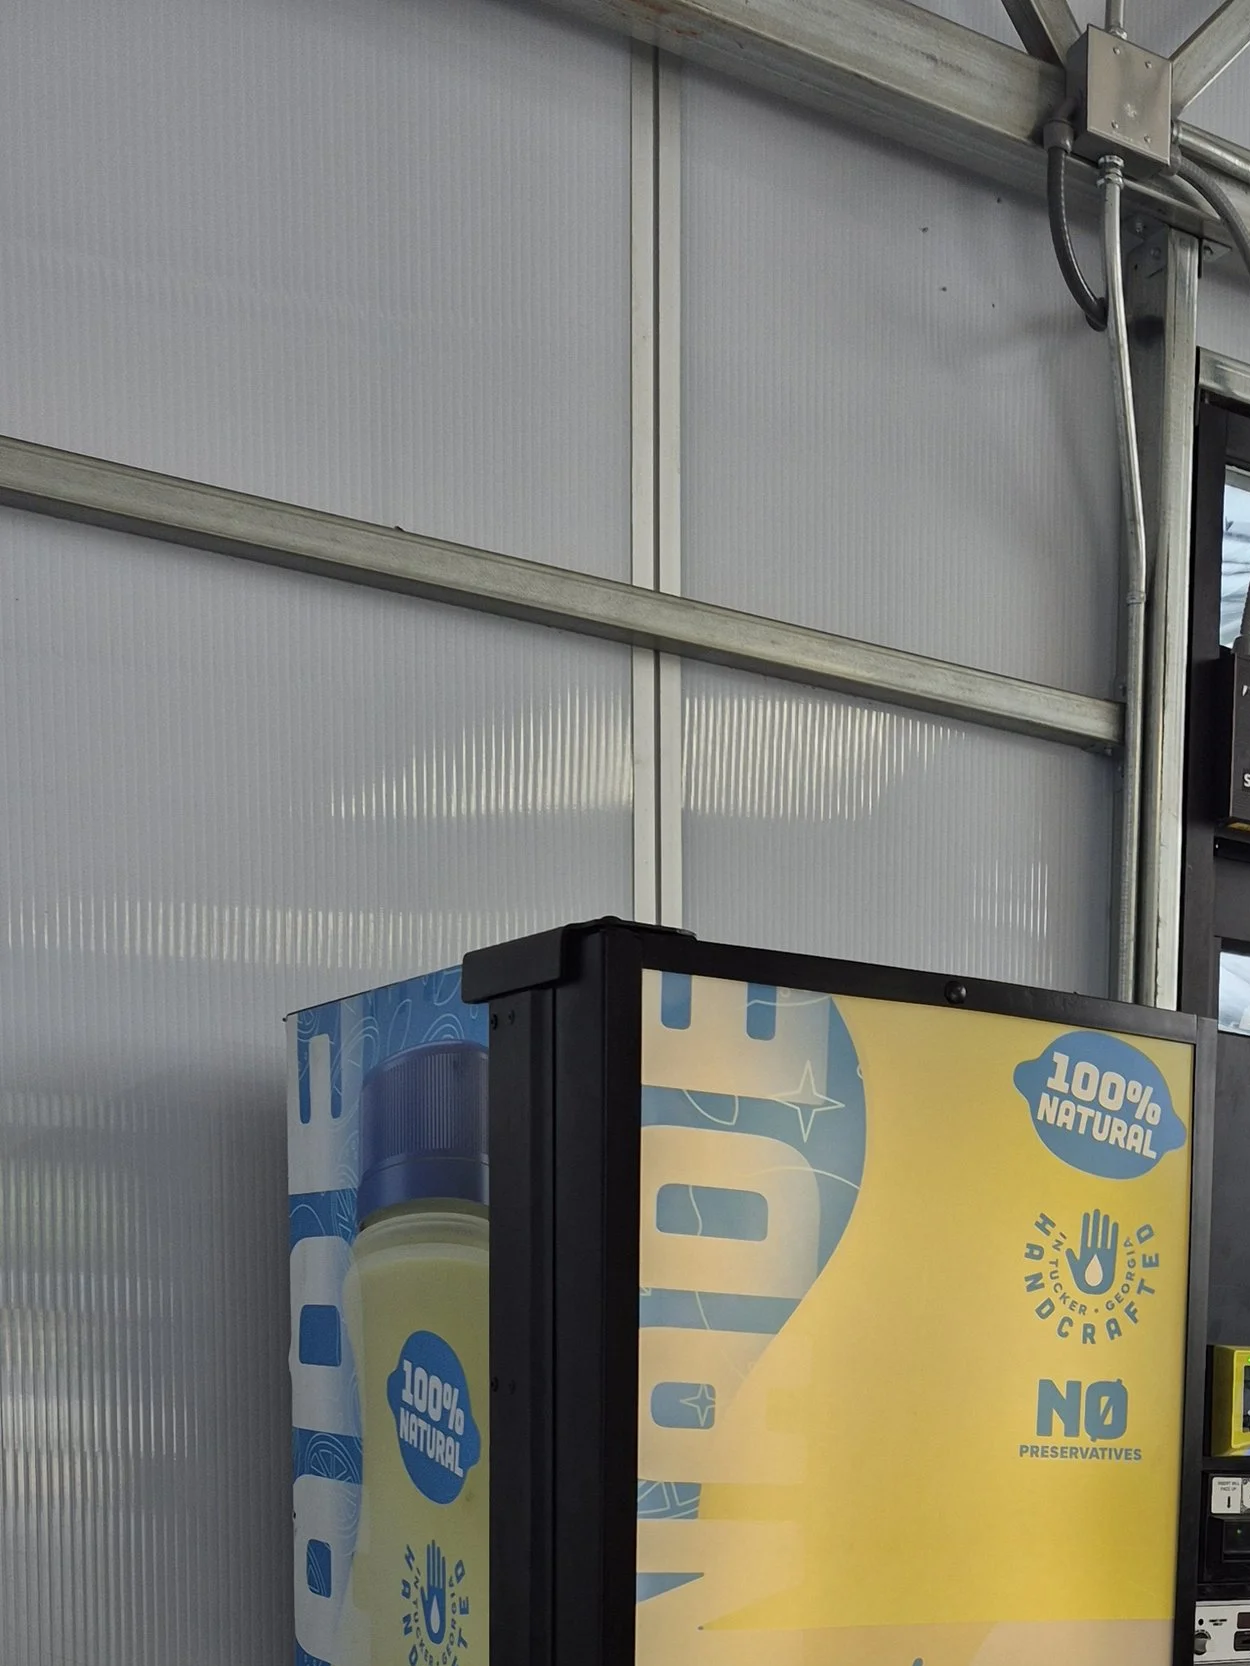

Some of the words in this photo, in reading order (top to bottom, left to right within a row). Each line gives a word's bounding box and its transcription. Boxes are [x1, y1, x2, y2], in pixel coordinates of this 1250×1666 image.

[1047, 1052, 1162, 1125] 100%
[1037, 1092, 1157, 1159] NATURAL
[1051, 1232, 1067, 1251] IN
[1105, 1237, 1136, 1311] GEORGIA
[1024, 1213, 1159, 1344] HANDCRAFTED
[1049, 1258, 1087, 1316] TUCKER
[401, 1359, 465, 1436] 100%
[399, 1407, 464, 1478] NATURAL
[1019, 1444, 1142, 1461] PRESERVATIVES
